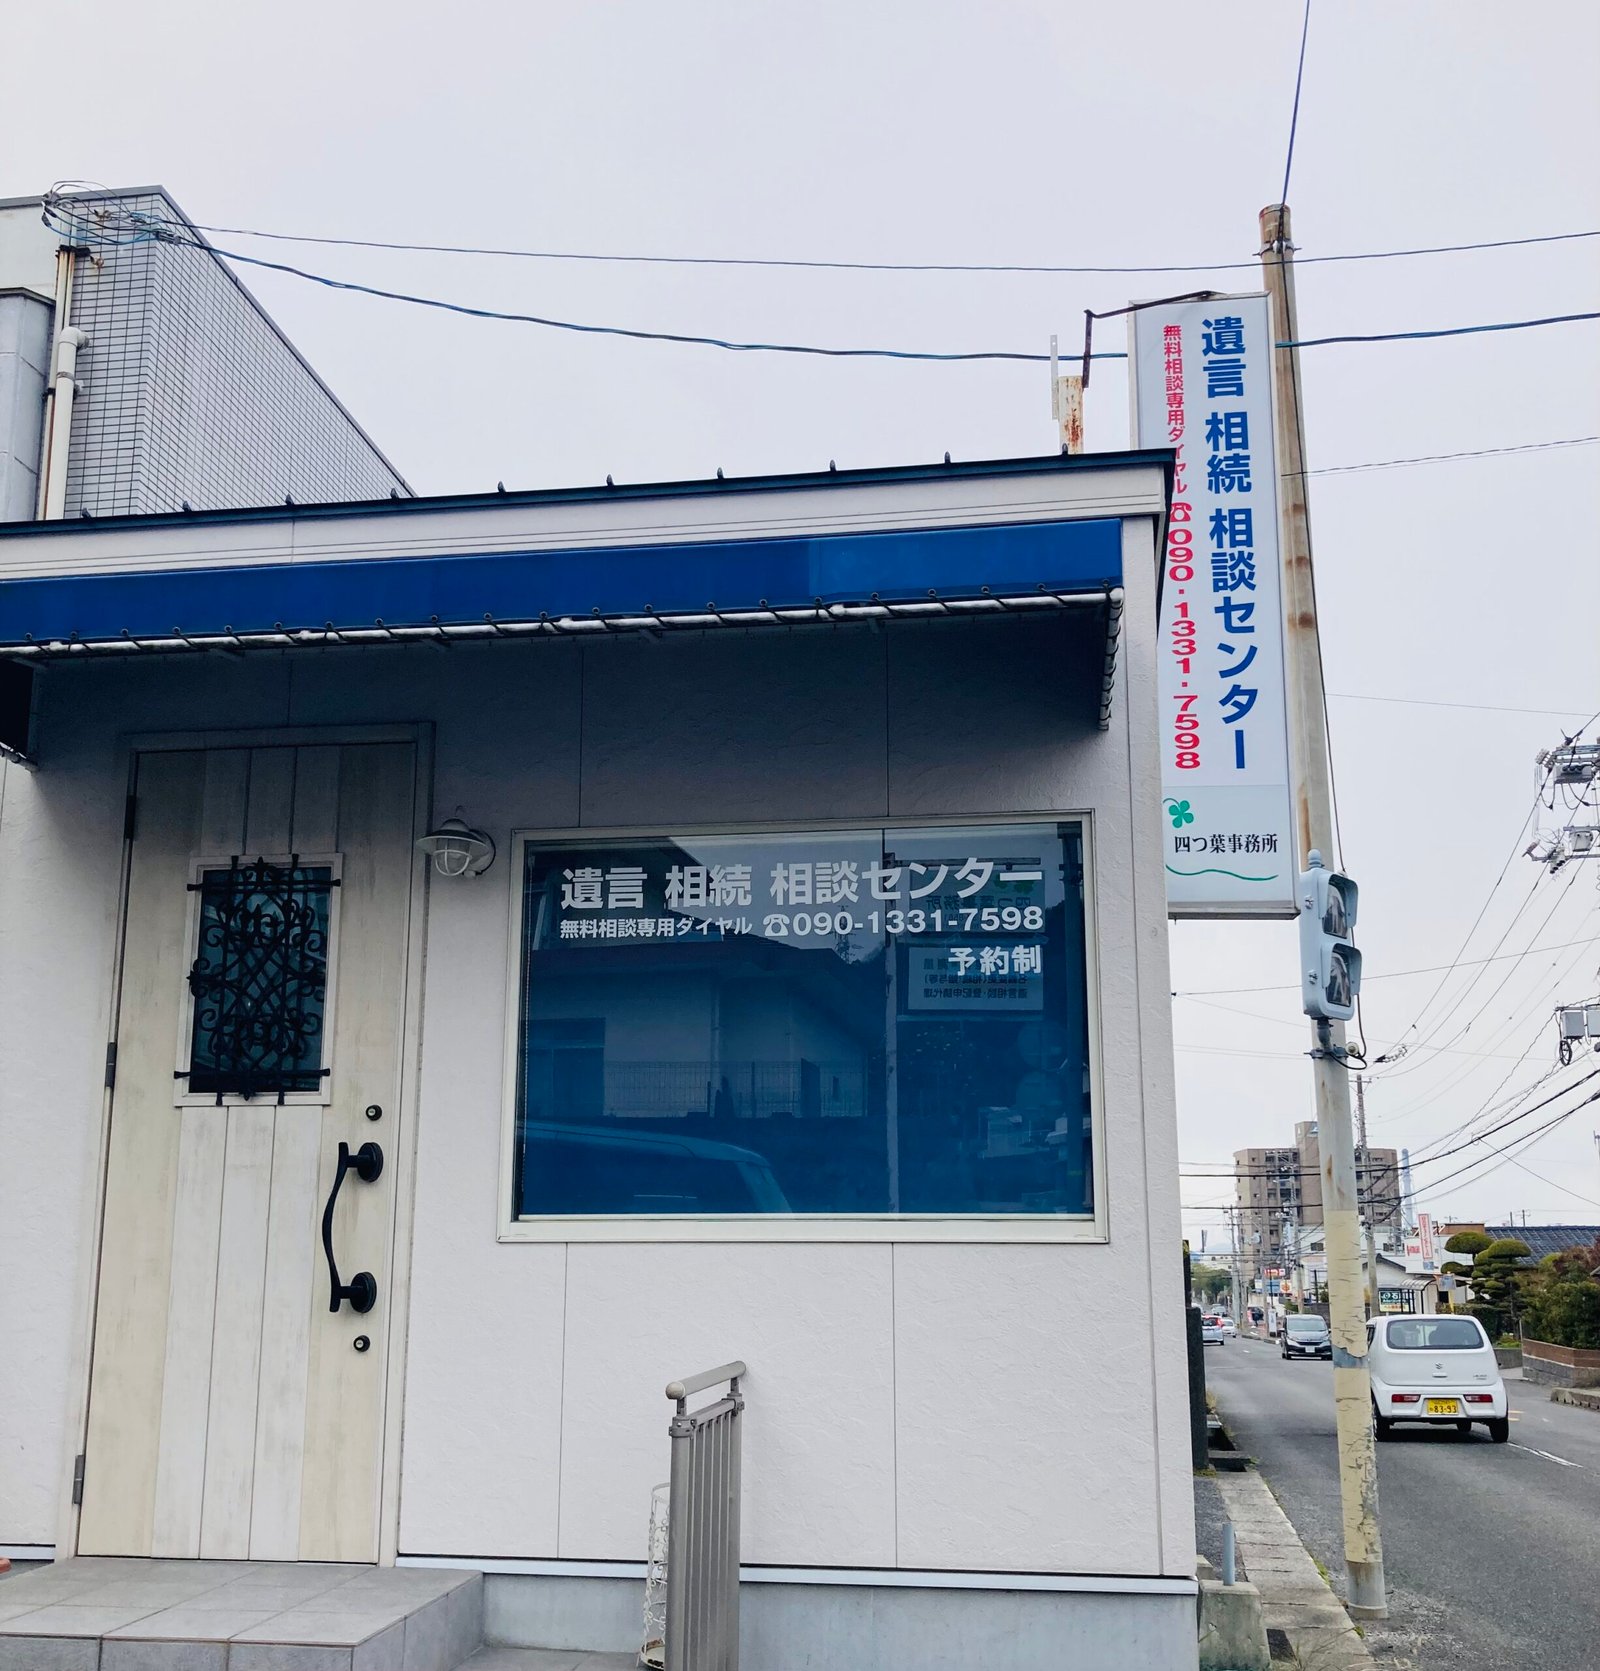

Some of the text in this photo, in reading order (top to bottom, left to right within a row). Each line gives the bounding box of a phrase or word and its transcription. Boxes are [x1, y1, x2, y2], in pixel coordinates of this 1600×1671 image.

[1201, 316, 1258, 769] 遺言 相続 相談センター
[1174, 833, 1278, 854] 四つ葉事務所
[560, 857, 1042, 910] 遺言 相続 相談センター
[560, 906, 1043, 939] 無料相談専用ダイヤル 090-1331-7598
[948, 944, 1042, 976] 予約制
